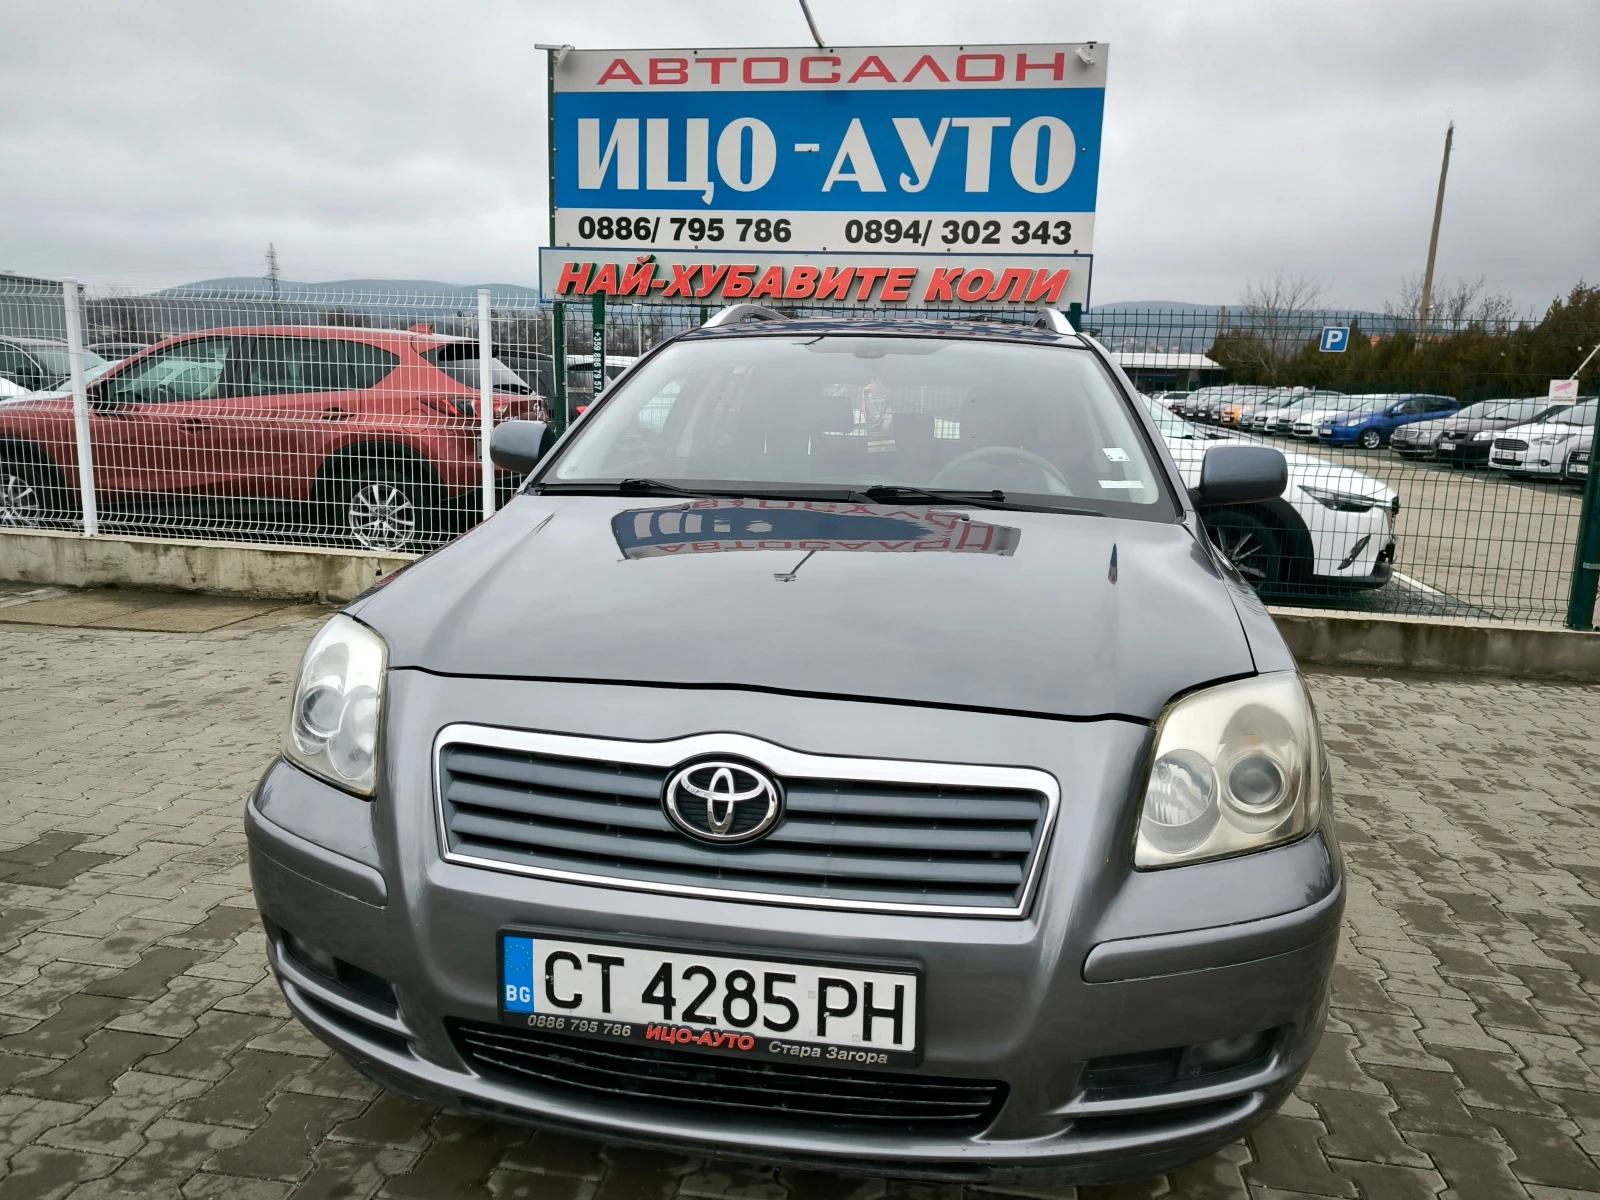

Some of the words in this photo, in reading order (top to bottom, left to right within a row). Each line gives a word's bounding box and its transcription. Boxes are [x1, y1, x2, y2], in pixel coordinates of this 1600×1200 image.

[597, 53, 1065, 85] АВТОСАЛОН
[578, 215, 661, 244] 0886/
[669, 217, 725, 242] 795
[735, 218, 792, 243] 786
[845, 219, 933, 247] 0894/
[941, 220, 1001, 245] 302
[1011, 220, 1072, 246] 343
[556, 255, 917, 302] НАЙ-ХУБАВИТЕ
[923, 267, 1071, 304] КОЛИ
[1325, 330, 1343, 349] P
[593, 352, 602, 368] 886
[593, 368, 602, 379] 79
[506, 984, 531, 1003] BG
[545, 950, 625, 1014] CT
[641, 962, 800, 1033] 4285
[816, 977, 905, 1045] PH
[527, 1014, 566, 1031] 0886
[570, 1018, 599, 1034] 795
[603, 1022, 632, 1037] 786
[645, 1024, 756, 1053] ИЦО-АУТО
[768, 1040, 821, 1060] Стара
[826, 1045, 888, 1066] Загора
